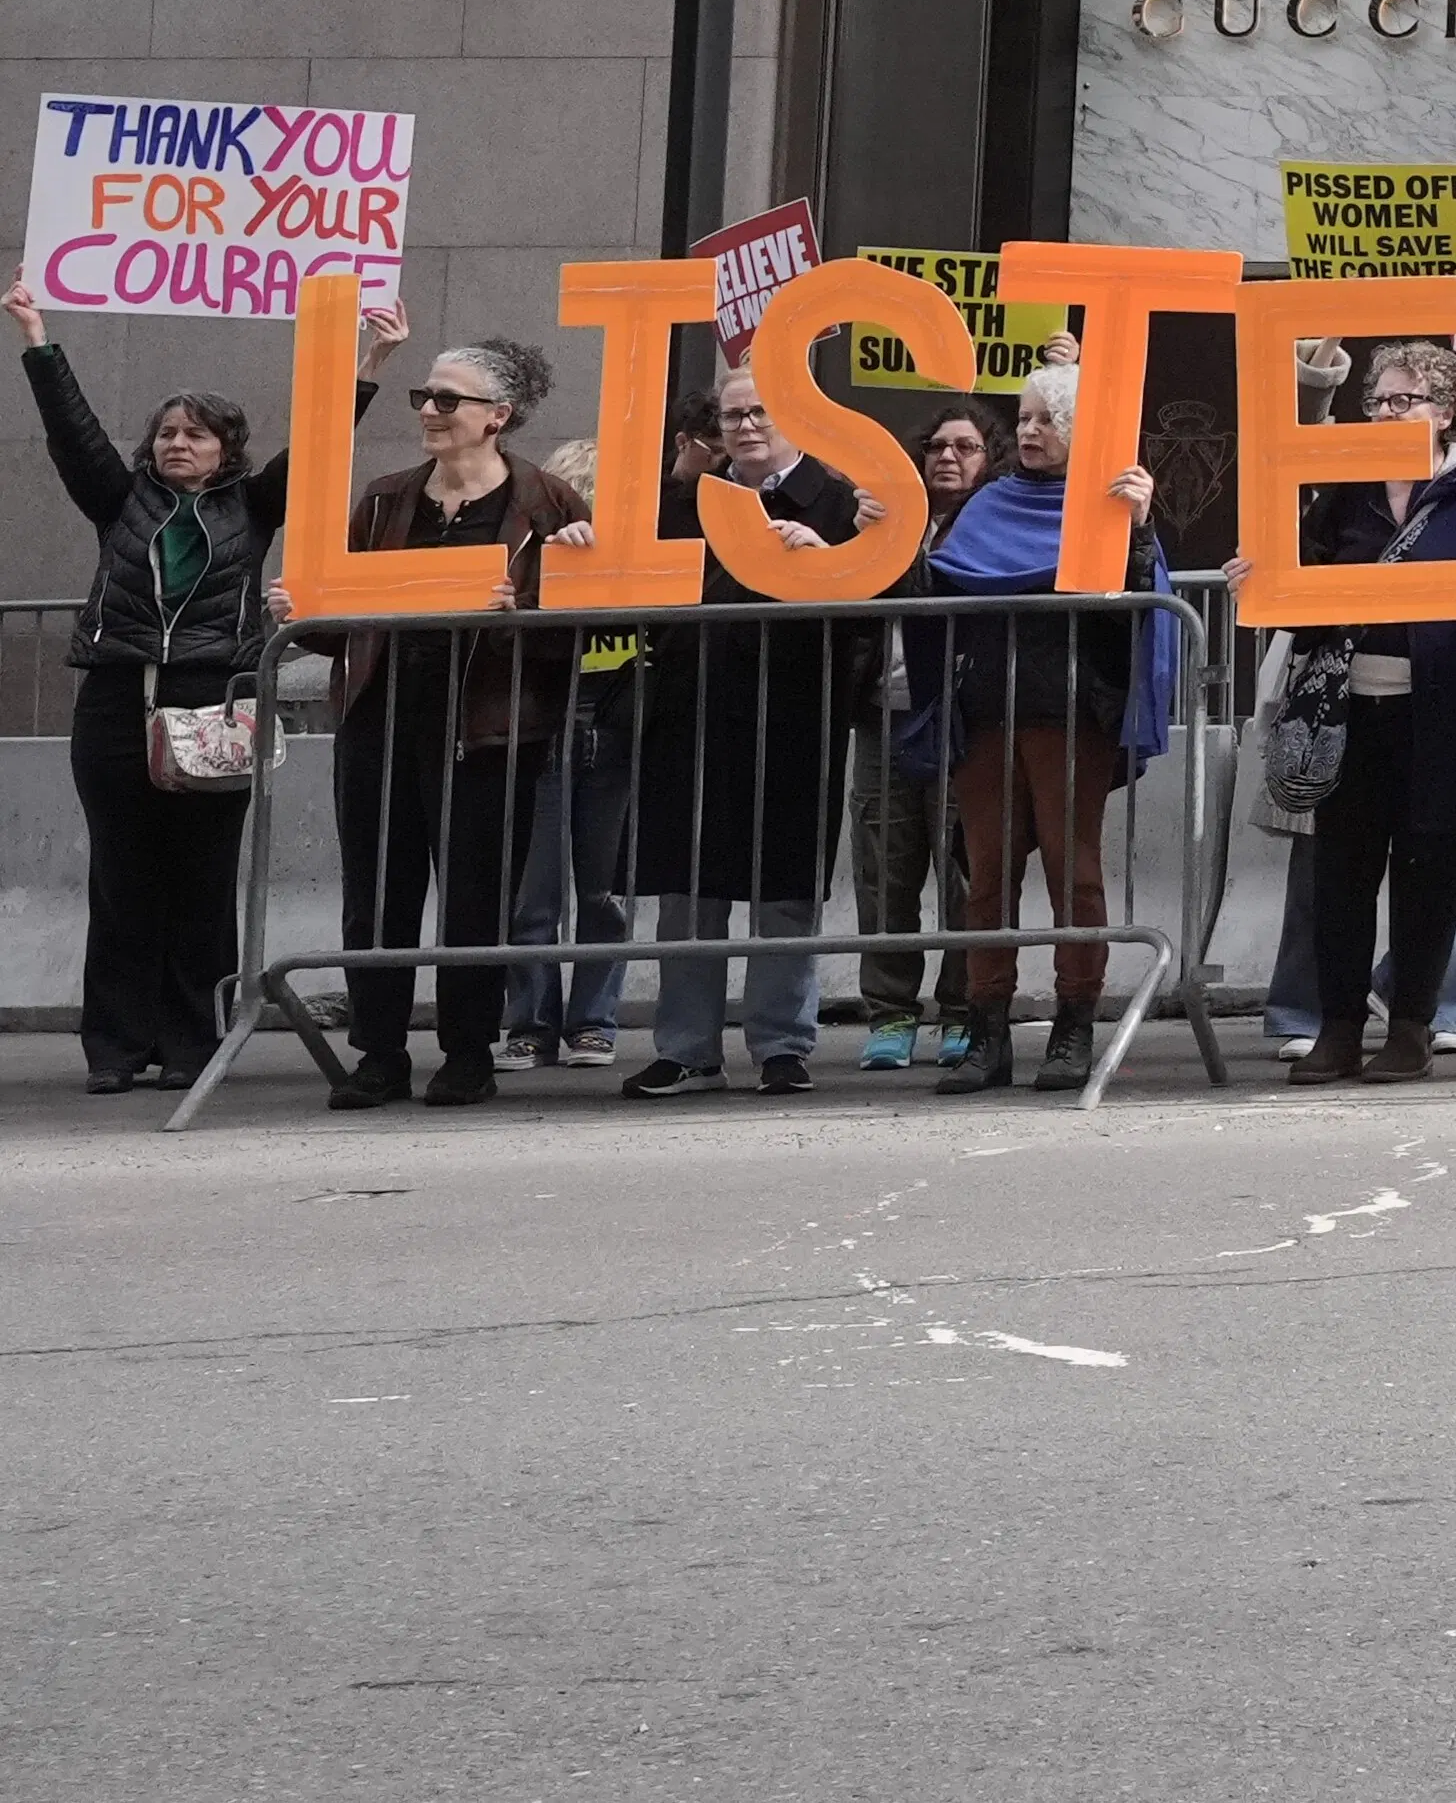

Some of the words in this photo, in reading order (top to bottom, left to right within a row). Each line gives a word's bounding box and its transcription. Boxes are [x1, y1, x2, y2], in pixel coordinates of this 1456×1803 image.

[47, 100, 262, 176] THANK
[263, 105, 412, 182] YOU
[1286, 171, 1395, 200] PISSED
[91, 173, 225, 236] FOR
[244, 174, 401, 249] YOUR
[1313, 202, 1439, 229] WOMEN
[1306, 233, 1368, 257] WILL
[1376, 234, 1453, 257] SAVE
[717, 223, 812, 307] ELIEVE
[937, 258, 1000, 299] STA
[1291, 257, 1333, 278] THE
